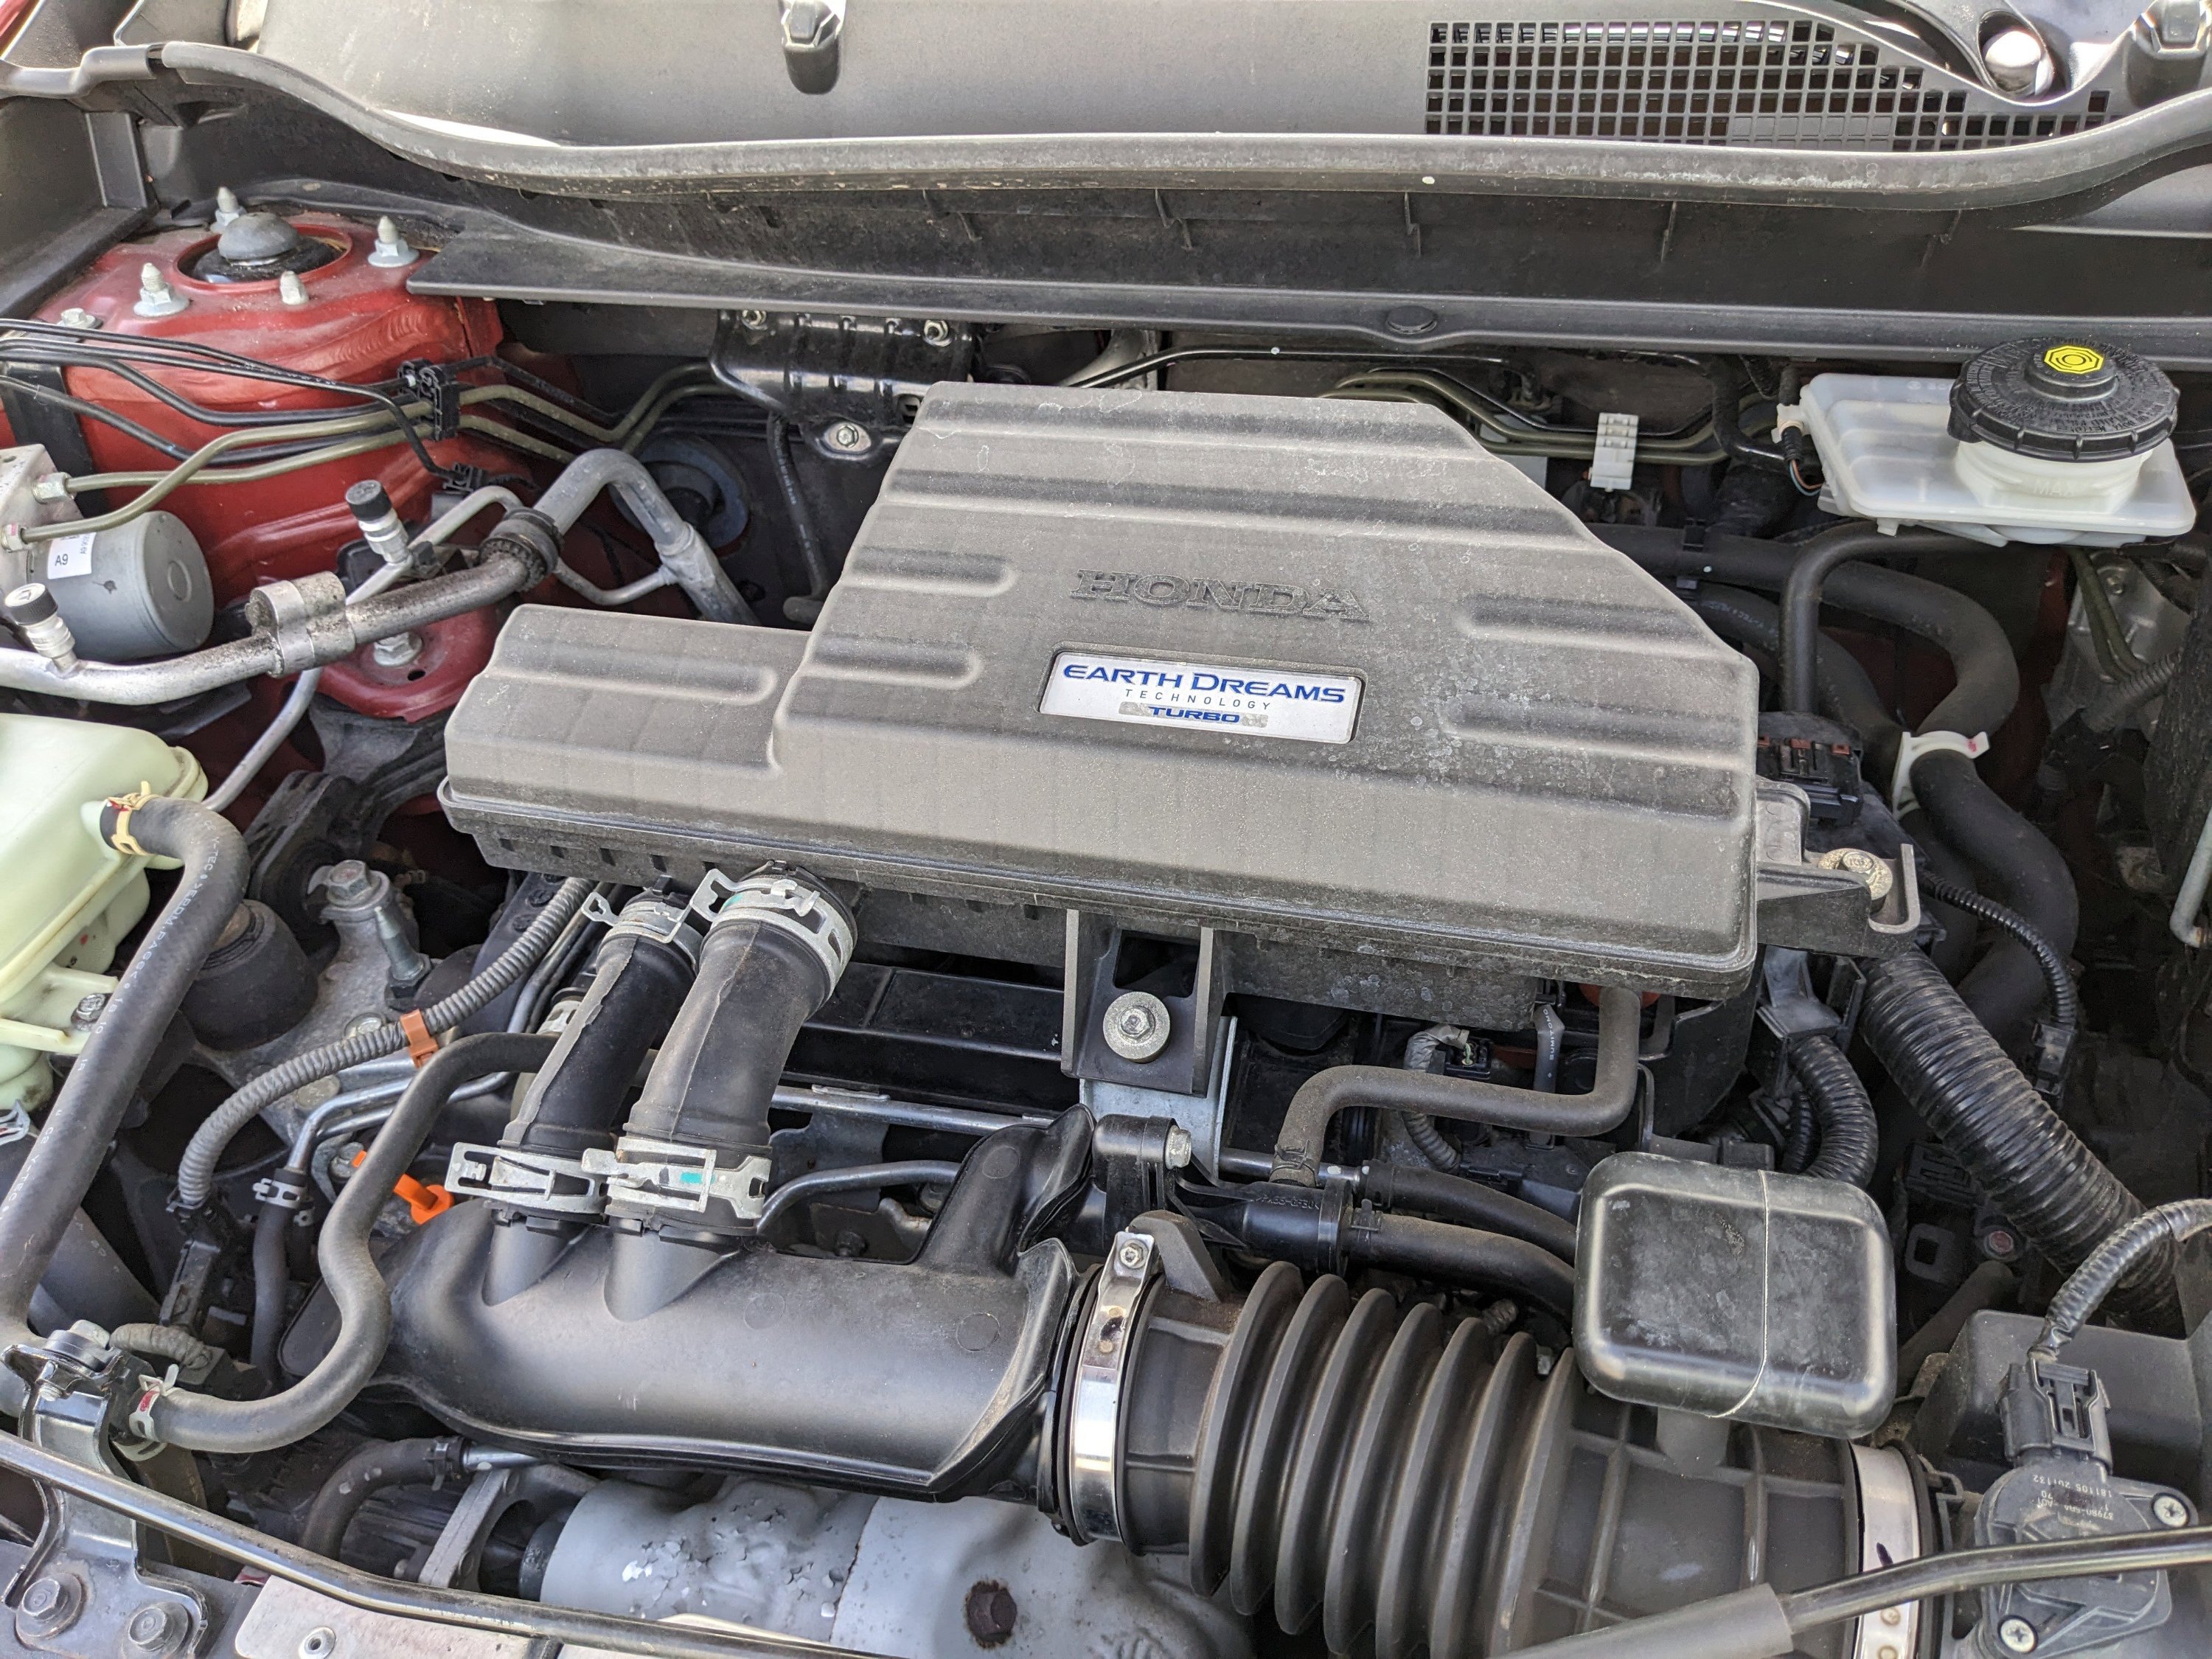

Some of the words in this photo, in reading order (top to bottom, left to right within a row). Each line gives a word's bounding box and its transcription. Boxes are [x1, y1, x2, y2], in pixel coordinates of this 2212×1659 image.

[2033, 479, 2076, 496] MAX
[55, 553, 69, 566] A9
[1069, 568, 1371, 621] HONDA
[1062, 663, 1183, 689] EARTH
[1191, 672, 1347, 703] DREAMS
[1124, 689, 1273, 711] TECHNOLOGY
[1147, 705, 1241, 723] TURBO
[1543, 1009, 1555, 1060] SUMITOMO
